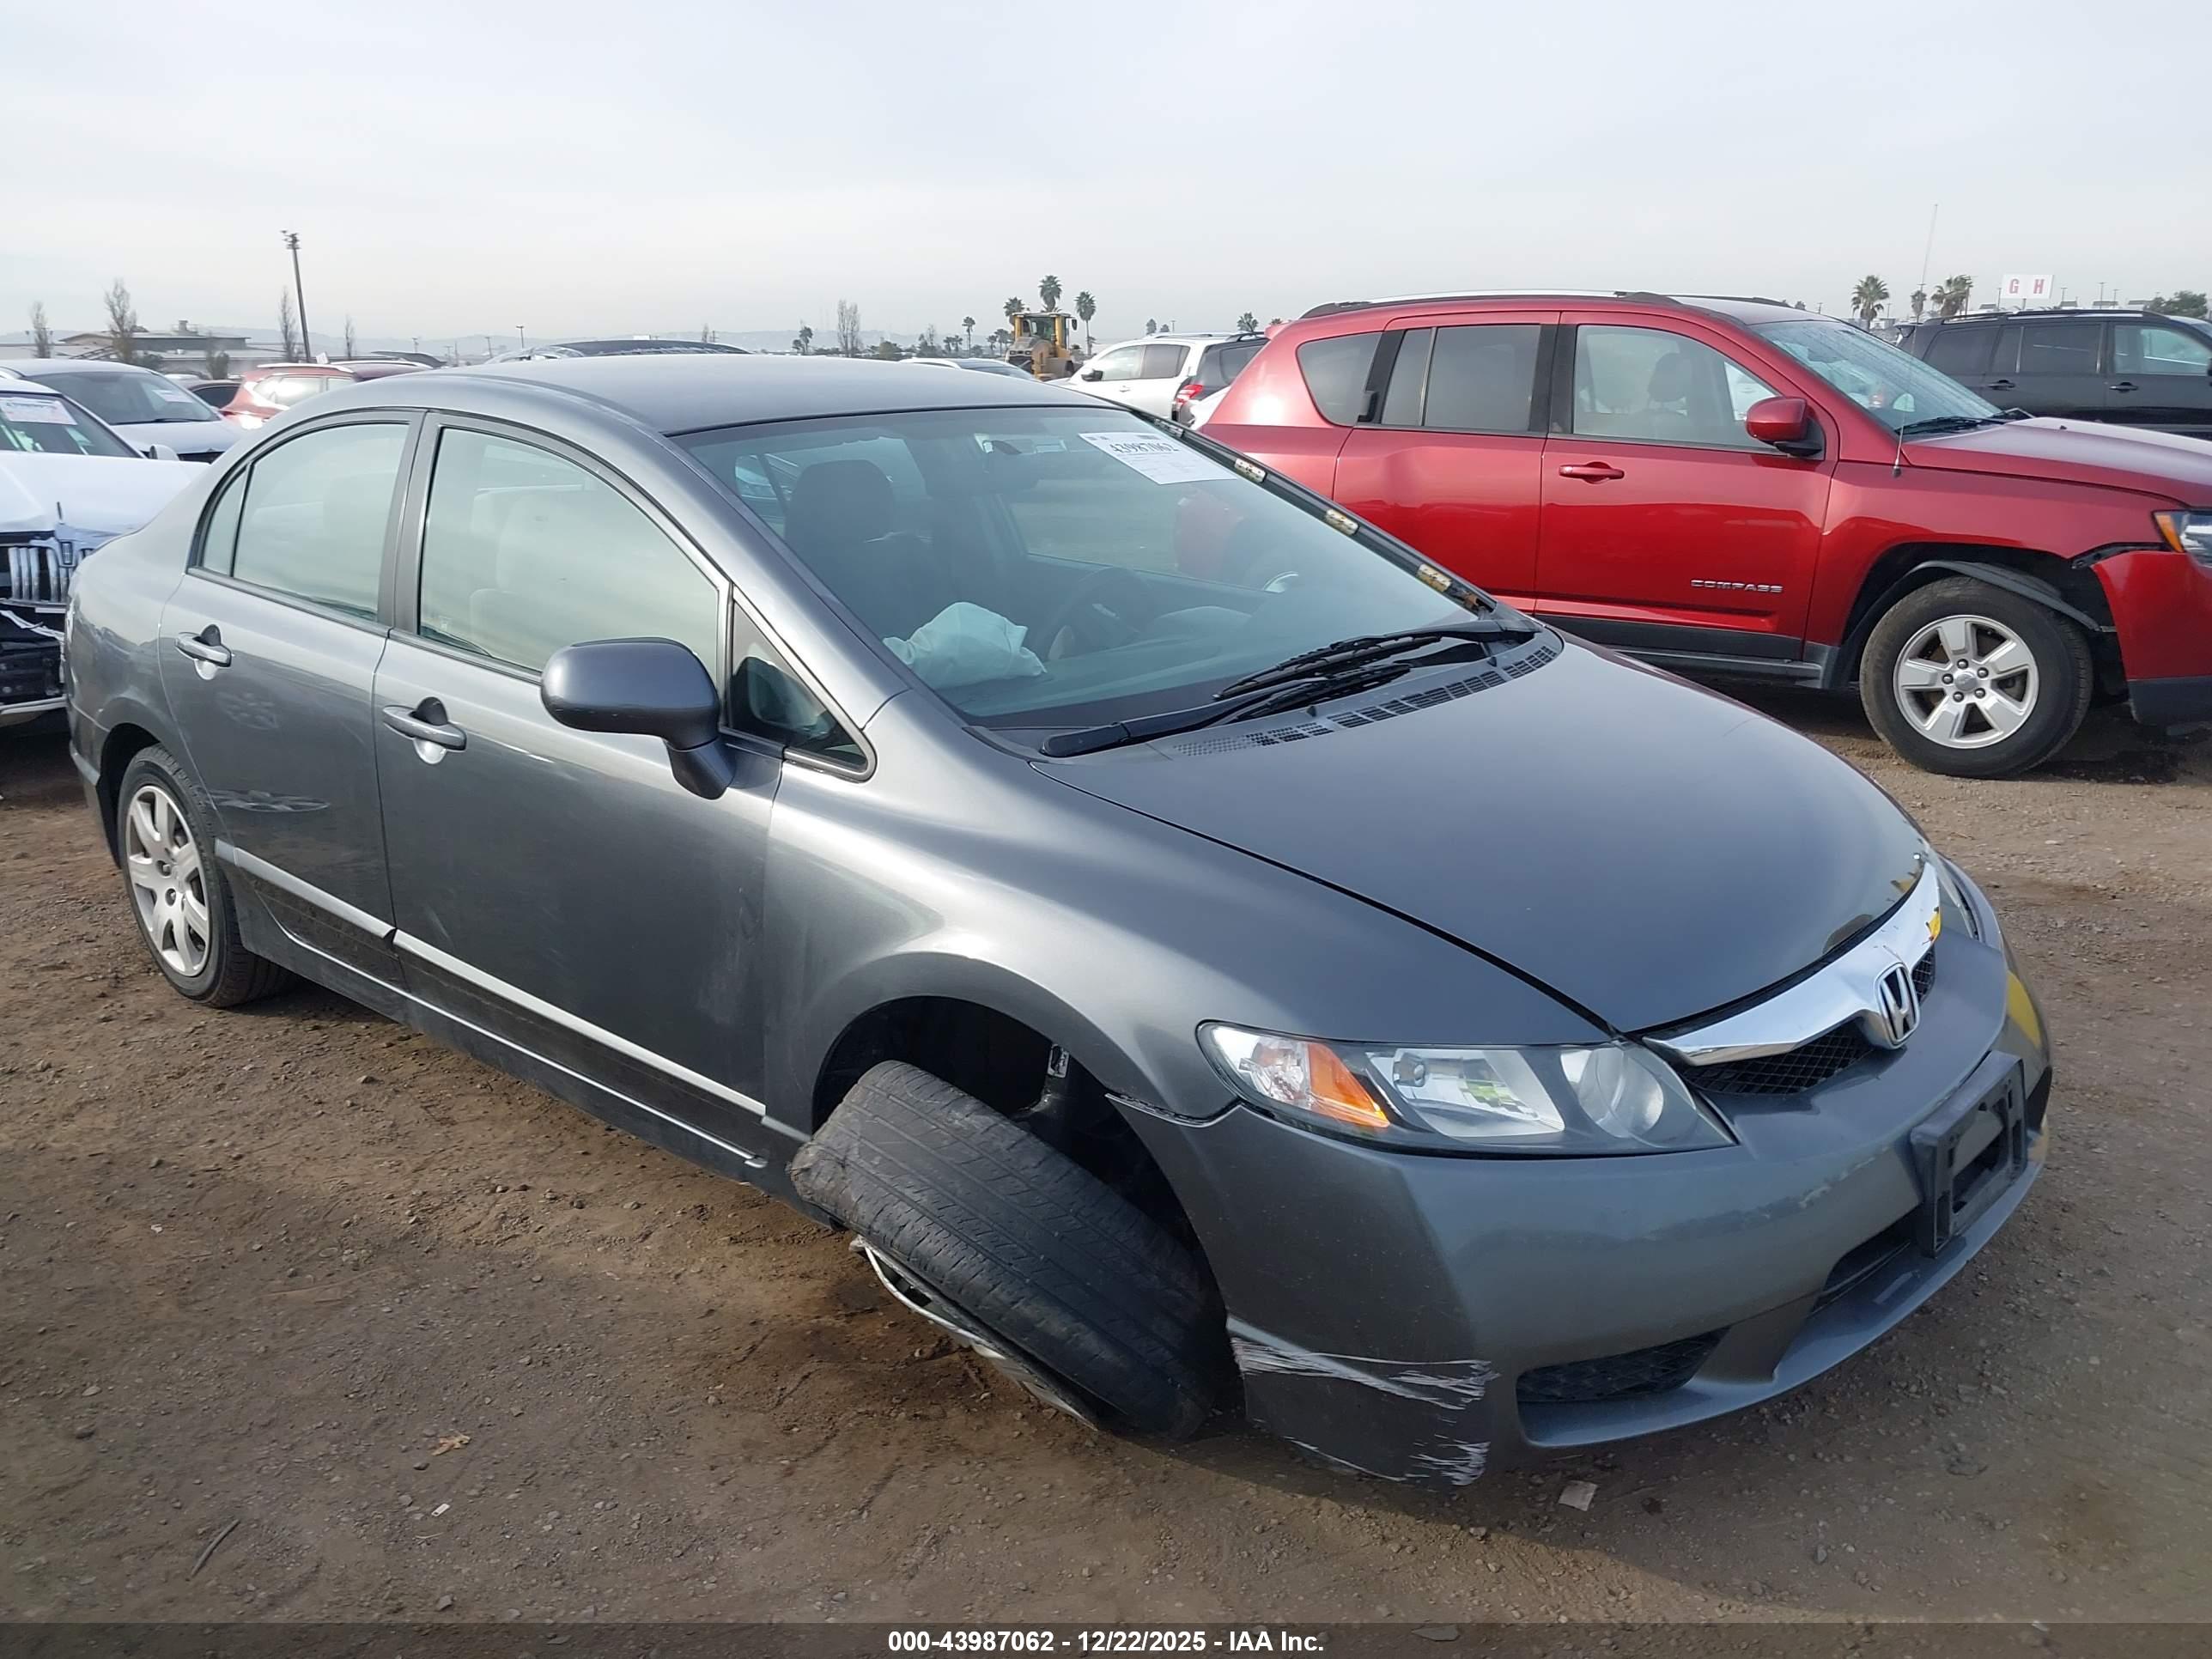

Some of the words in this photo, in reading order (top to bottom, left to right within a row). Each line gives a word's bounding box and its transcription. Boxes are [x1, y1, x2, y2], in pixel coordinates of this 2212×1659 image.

[2008, 278, 2021, 295] G
[2033, 278, 2045, 295] H
[1690, 579, 1784, 593] COMPASS
